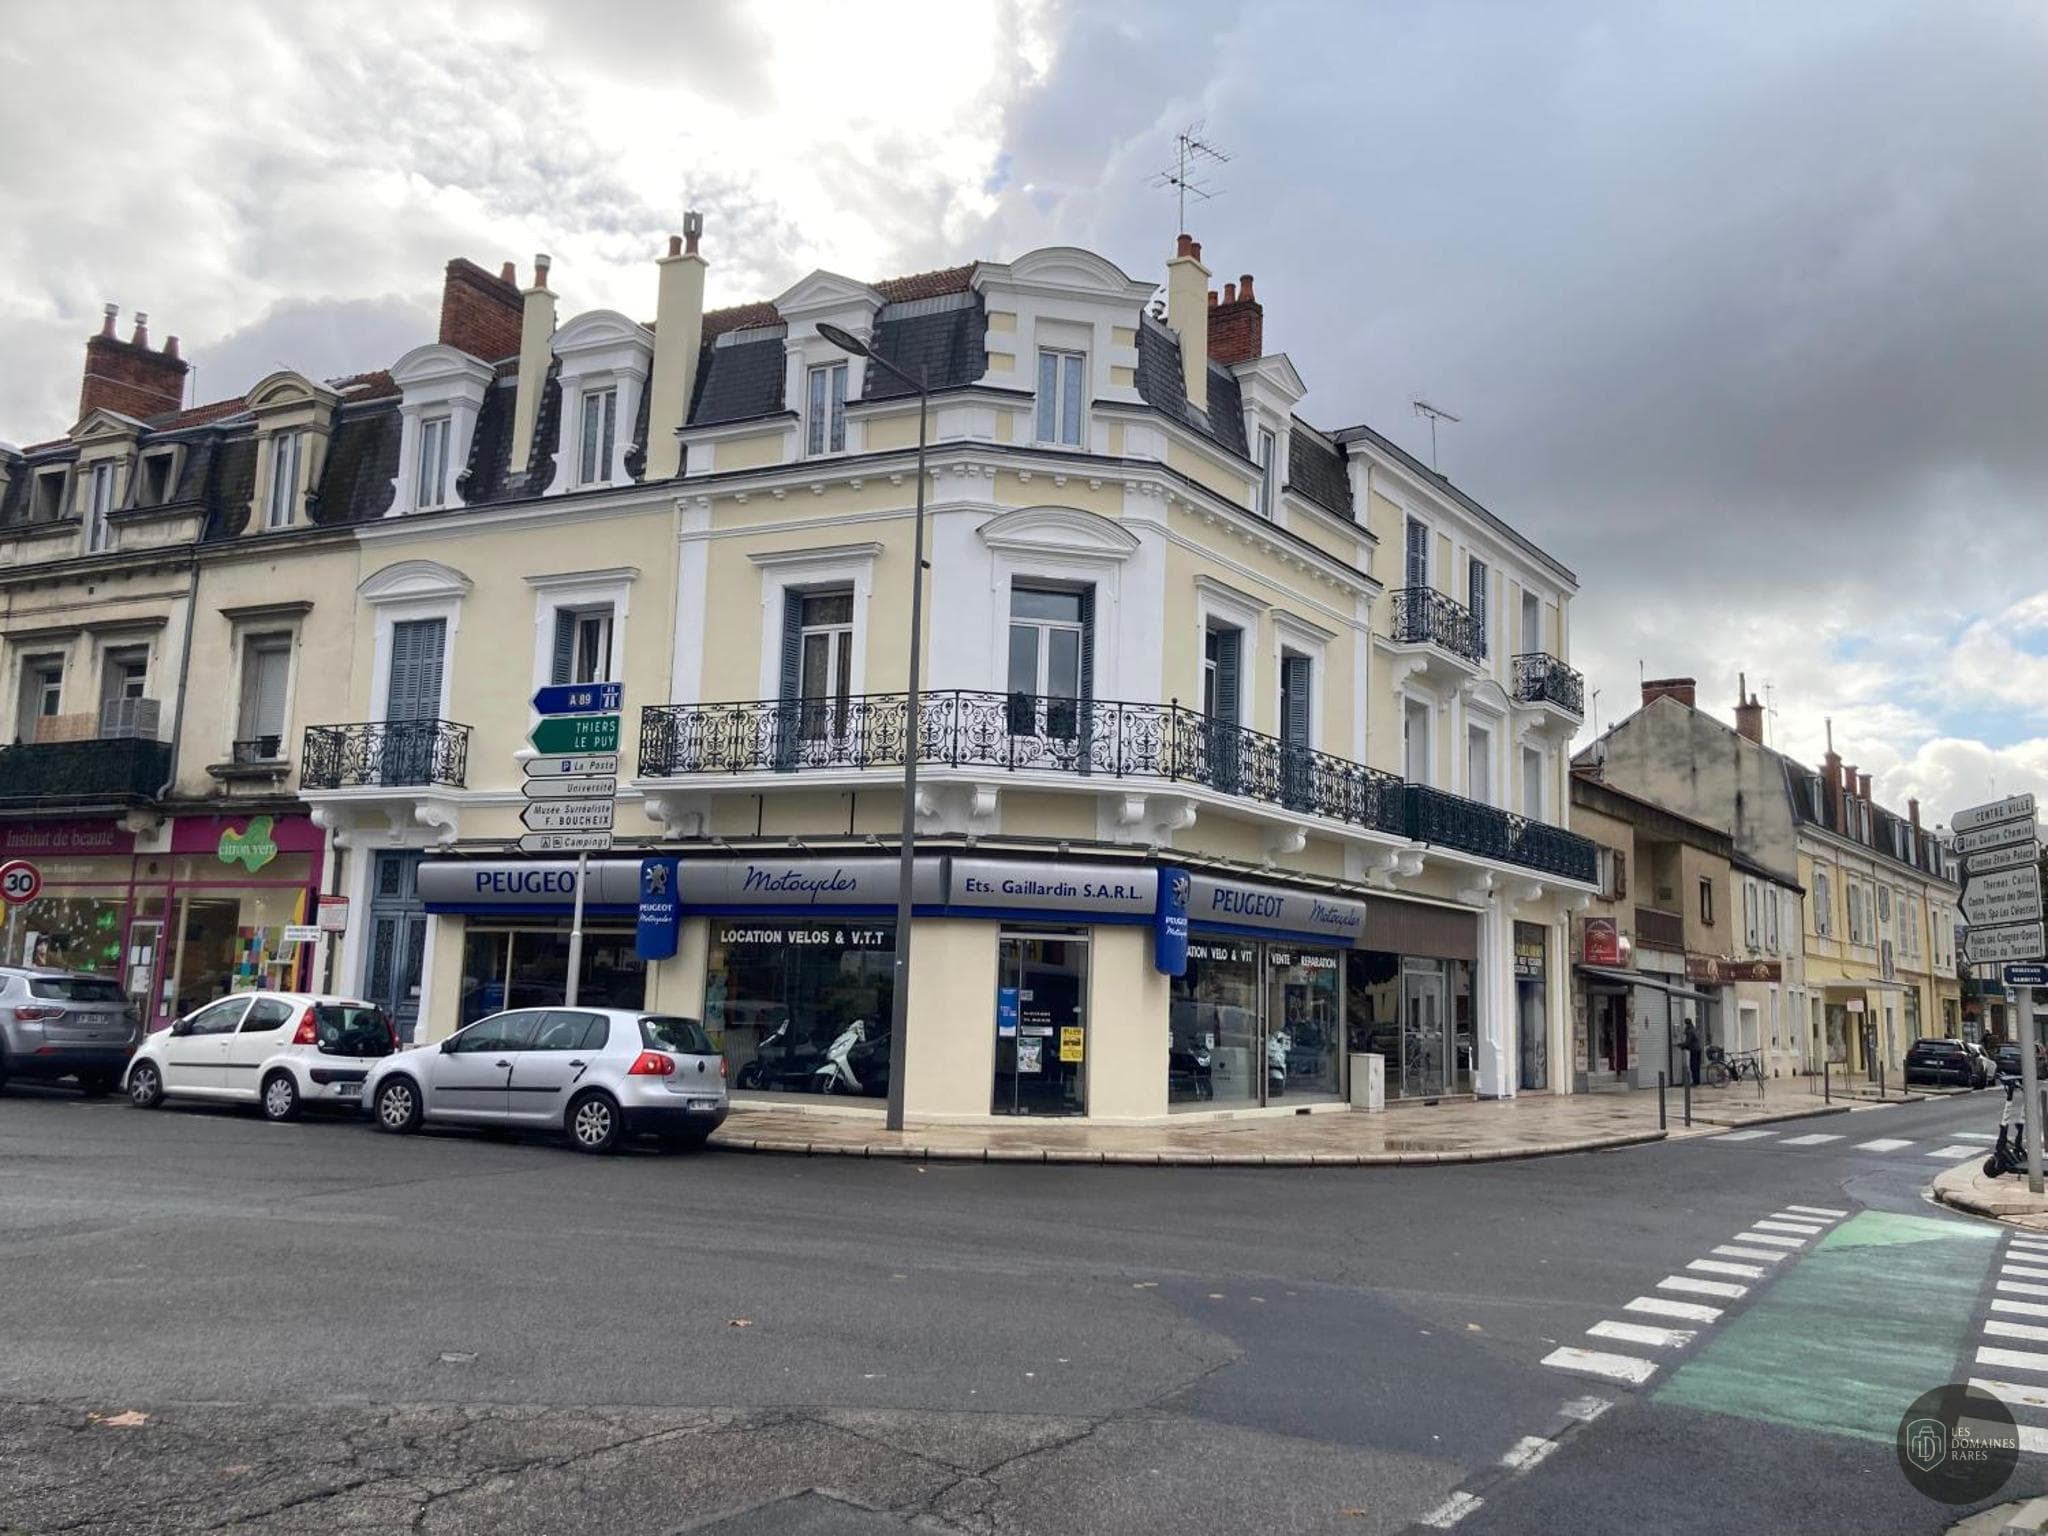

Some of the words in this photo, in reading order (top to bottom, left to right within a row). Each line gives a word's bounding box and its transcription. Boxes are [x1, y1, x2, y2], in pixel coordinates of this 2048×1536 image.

[569, 693, 576, 706] A
[578, 692, 591, 704] 89
[576, 721, 616, 733] THIERS
[574, 736, 586, 748] LE
[594, 735, 615, 748] PUY
[574, 761, 584, 771] La
[590, 760, 614, 771] Poste
[567, 783, 613, 794] Université
[534, 805, 560, 815] Musée
[564, 804, 610, 814] Surréaliste
[1976, 806, 2004, 823] CENTRE
[2008, 799, 2030, 814] VILLE
[545, 817, 554, 826] F.
[559, 815, 609, 826] BOUCHEIX
[7, 830, 49, 848] Institut
[52, 828, 69, 847] de
[70, 828, 115, 847] beauté
[564, 837, 608, 849] Campings
[220, 842, 251, 856] citron
[6, 873, 34, 893] 30
[743, 866, 857, 903] Motocycles
[965, 878, 995, 894] Ets.
[1002, 879, 1078, 898] Gaillardin
[1083, 884, 1143, 900] S.A.R.L.
[639, 904, 673, 912] PEUGEOT
[1211, 888, 1285, 918] PEUGEOT
[720, 930, 782, 944] LOCATION
[788, 930, 830, 944] VELOS
[835, 931, 845, 945] &
[851, 931, 884, 945] V.T.T
[1211, 947, 1229, 960] VELO
[1231, 948, 1238, 961] &
[1271, 953, 1291, 966] VENTE
[1300, 955, 1337, 969] REPARATION
